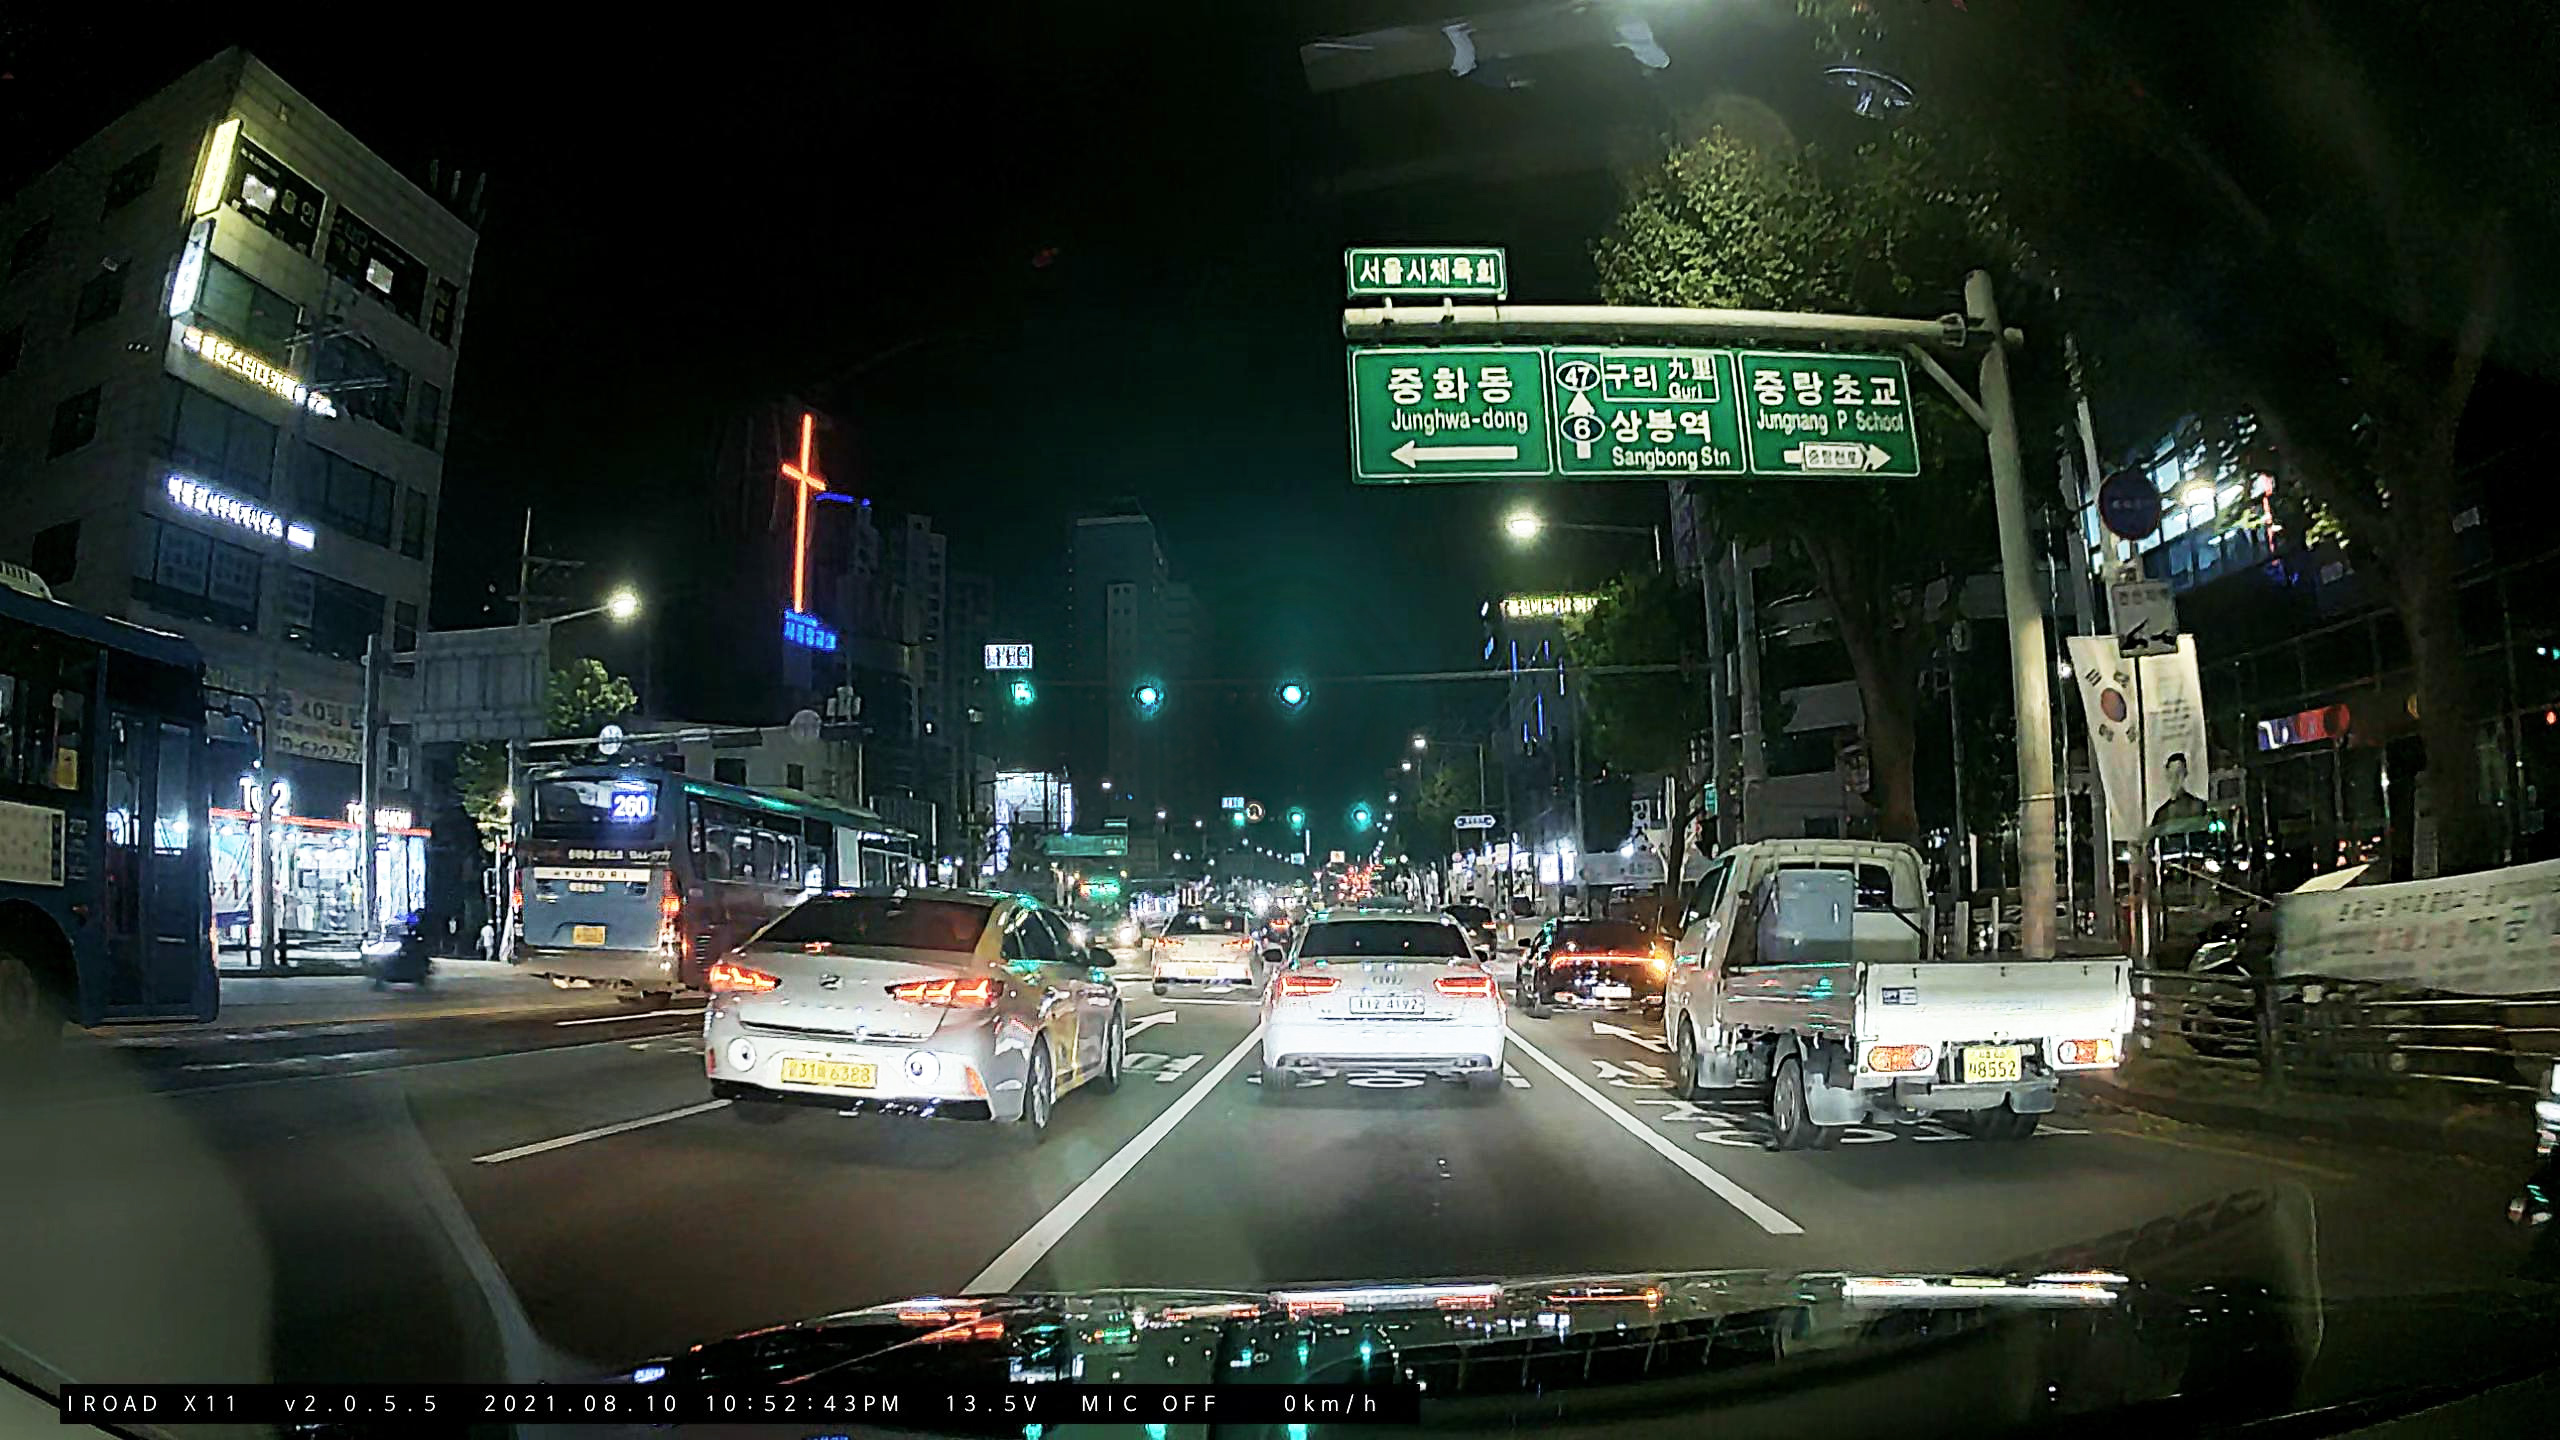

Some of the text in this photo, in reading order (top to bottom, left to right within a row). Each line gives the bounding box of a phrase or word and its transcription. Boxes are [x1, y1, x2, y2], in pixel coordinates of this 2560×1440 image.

[1360, 257, 1496, 286] 서울시체육회
[1388, 367, 1513, 405] 중화동
[1564, 366, 1591, 388] 47
[1605, 357, 1715, 391] 구리 九里
[1753, 370, 1902, 406] 중랑초교
[1669, 382, 1703, 400] Guri
[1391, 407, 1528, 436] Junghwa-dong
[1574, 418, 1591, 439] 6
[1611, 409, 1711, 443] 상봉역
[1757, 406, 1904, 436] Jungnang P School
[1612, 445, 1731, 472] Sangbong Stn
[613, 795, 649, 817] 260
